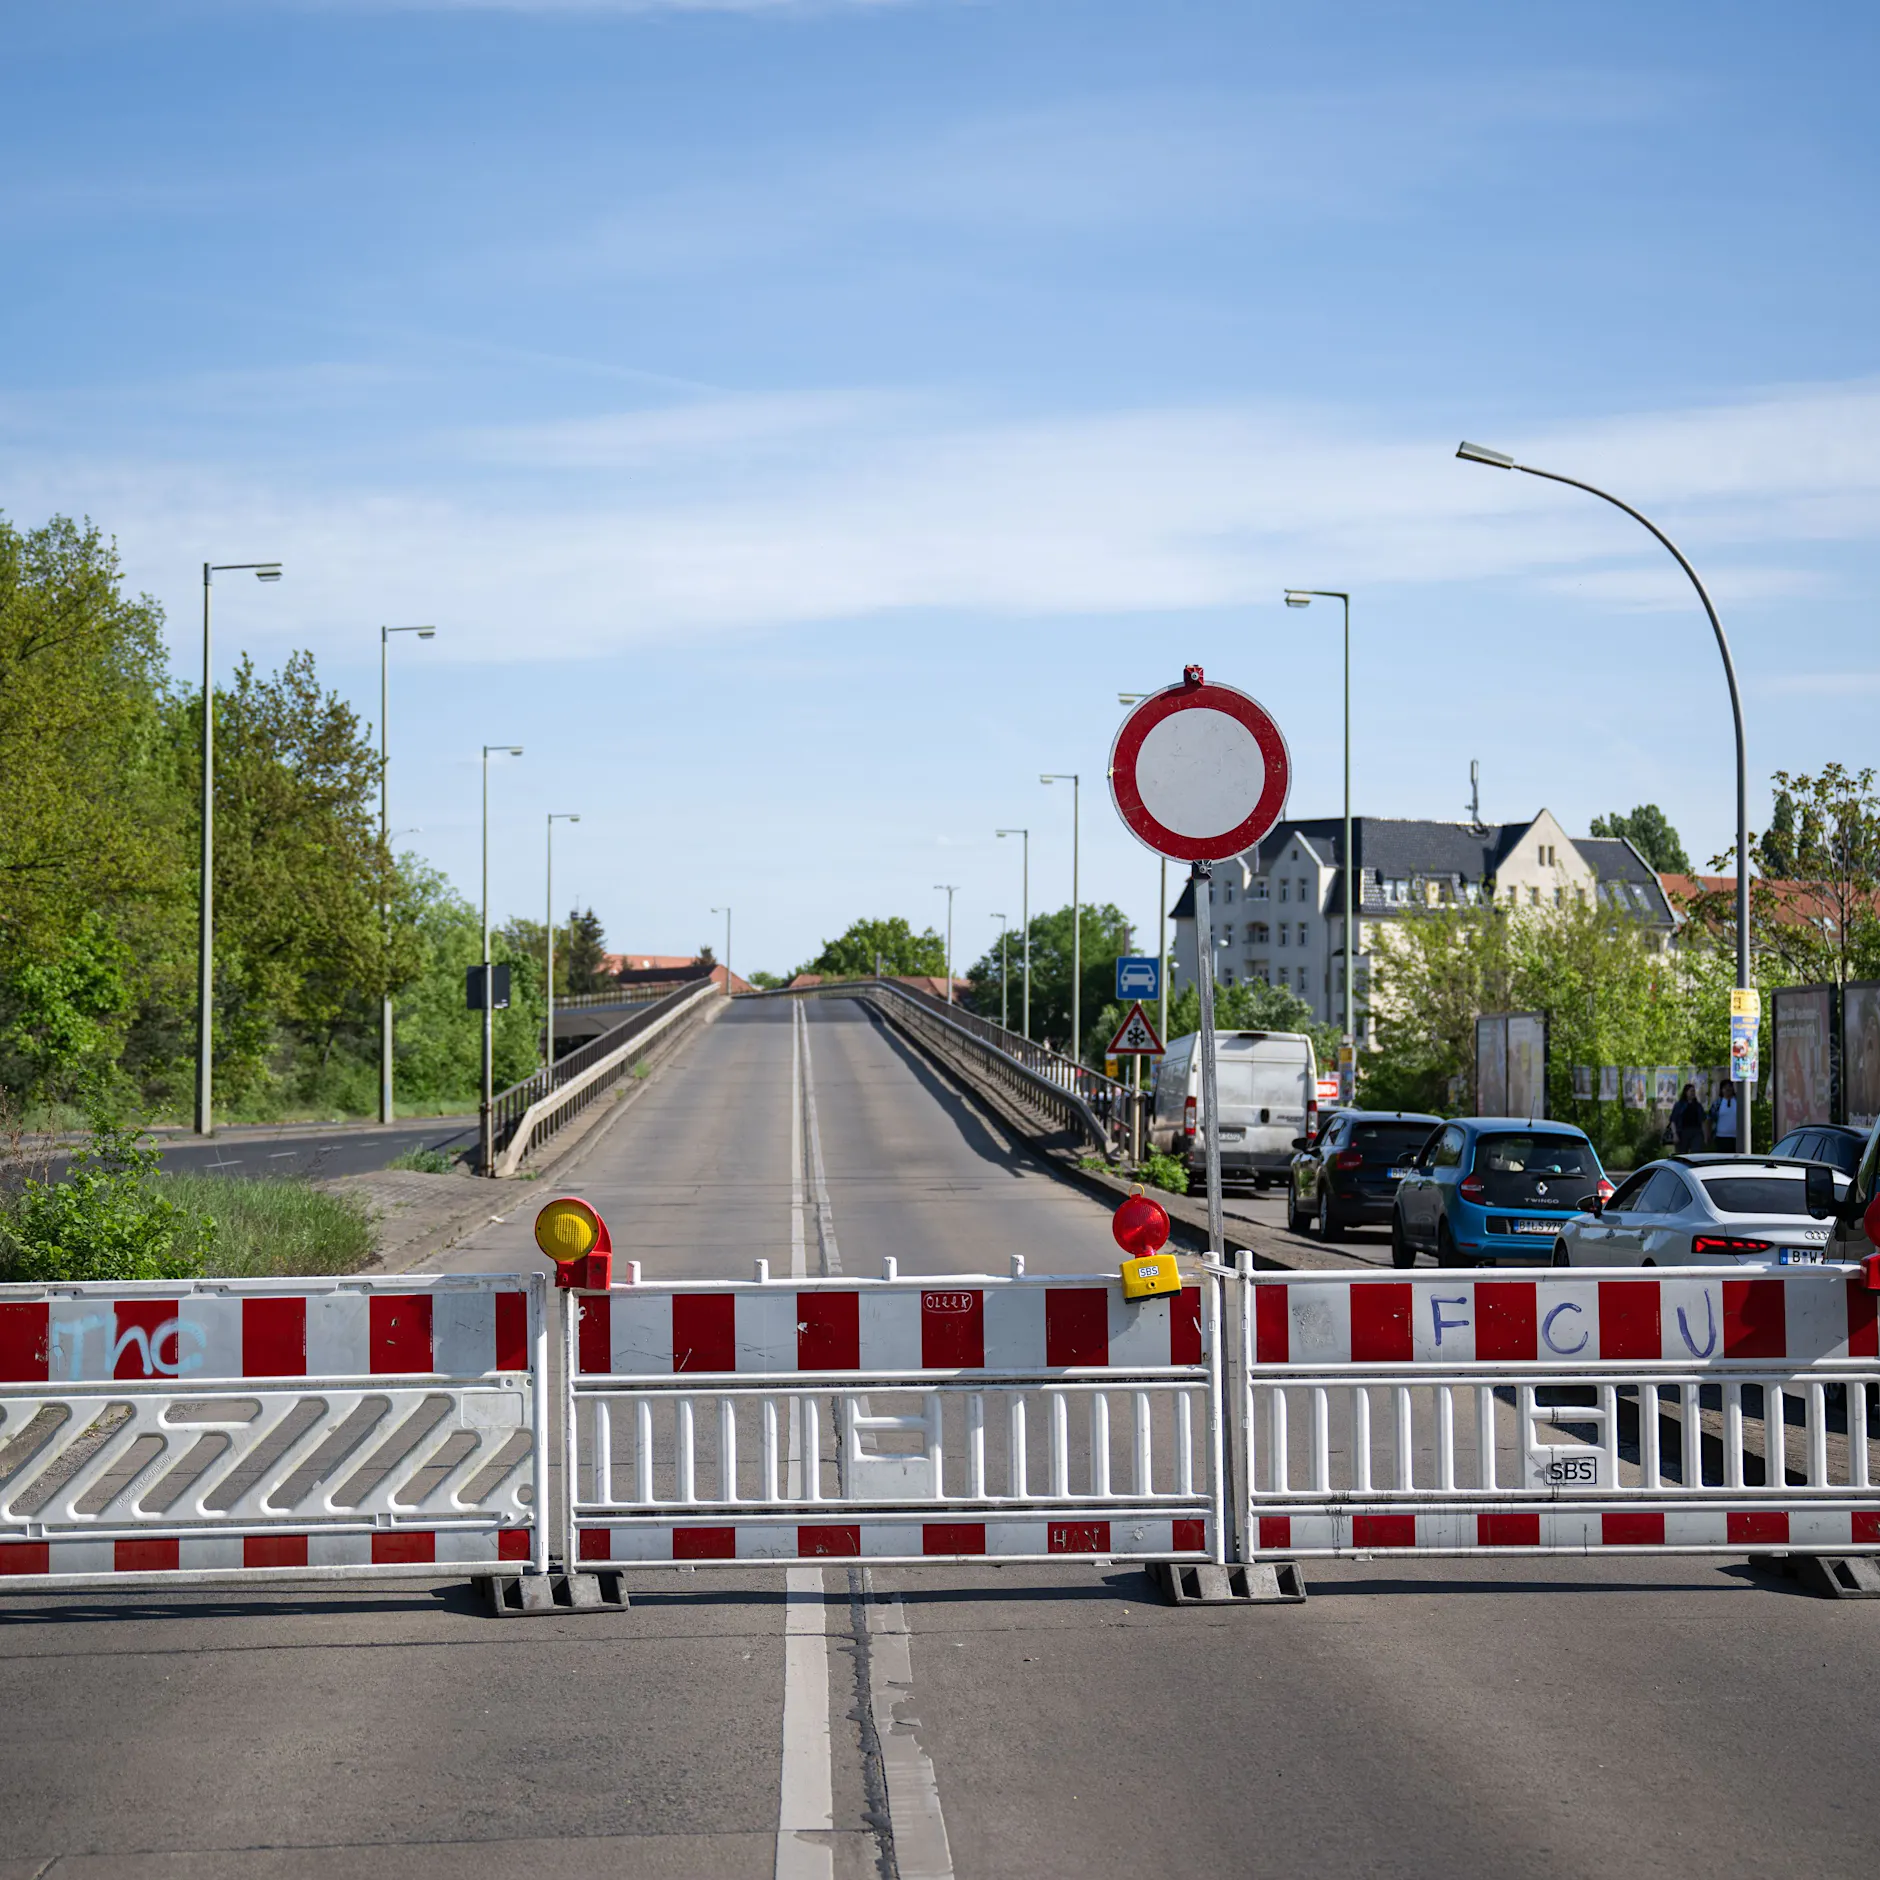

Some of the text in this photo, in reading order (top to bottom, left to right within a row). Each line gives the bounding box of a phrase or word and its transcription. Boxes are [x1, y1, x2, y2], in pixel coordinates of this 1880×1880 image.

[1524, 1197, 1560, 1205] TWINGO
[1519, 1220, 1526, 1231] B
[1792, 1250, 1801, 1263] B
[1140, 1266, 1158, 1277] SBS
[1550, 1462, 1592, 1480] SBS
